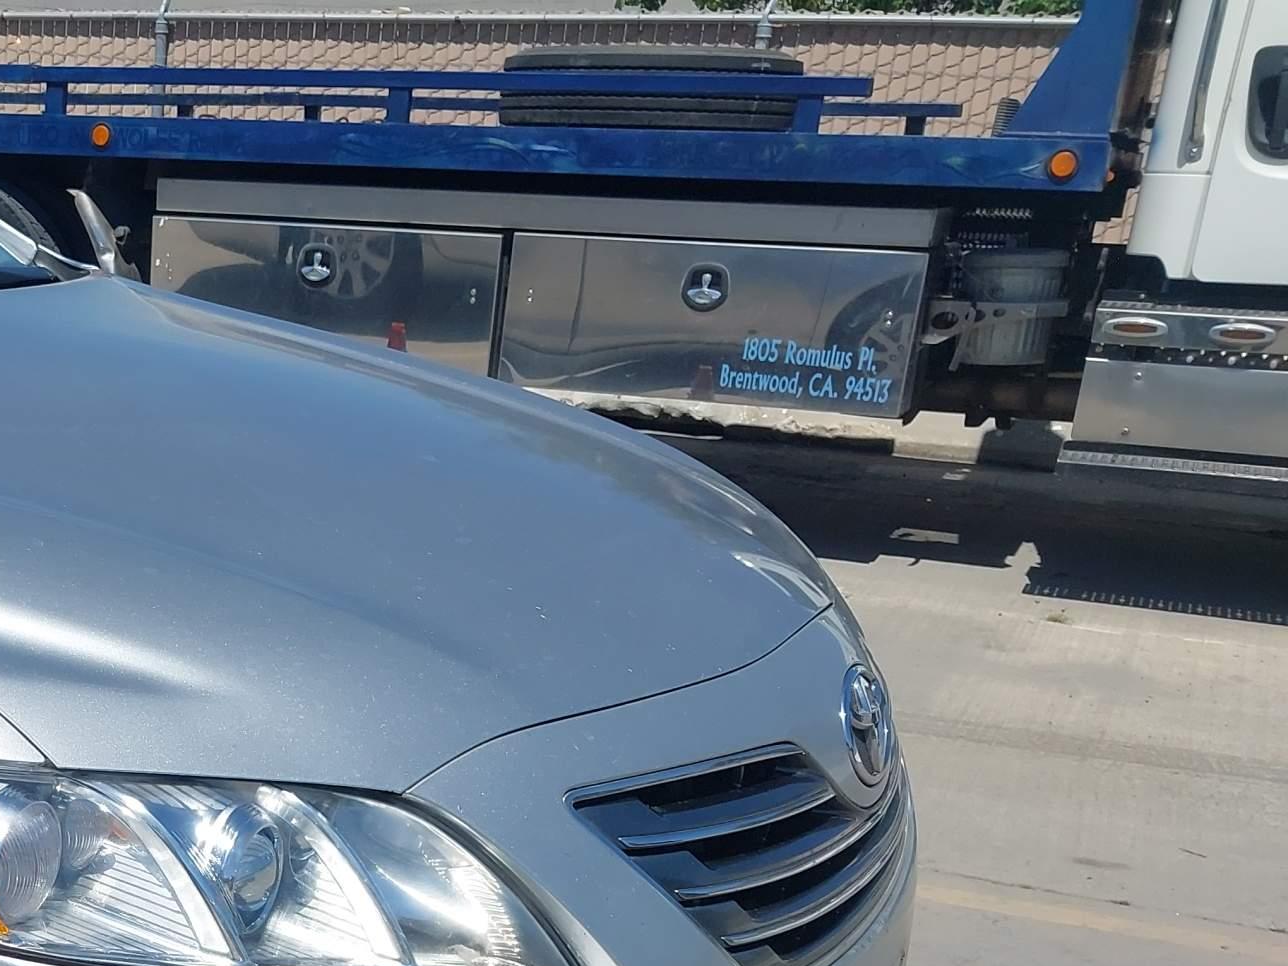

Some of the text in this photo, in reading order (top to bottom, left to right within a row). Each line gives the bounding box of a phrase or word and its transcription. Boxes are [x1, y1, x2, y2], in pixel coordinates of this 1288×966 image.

[742, 336, 877, 374] 1805 Romulus Pl.
[719, 364, 891, 403] Brentwood, CA. 94513
